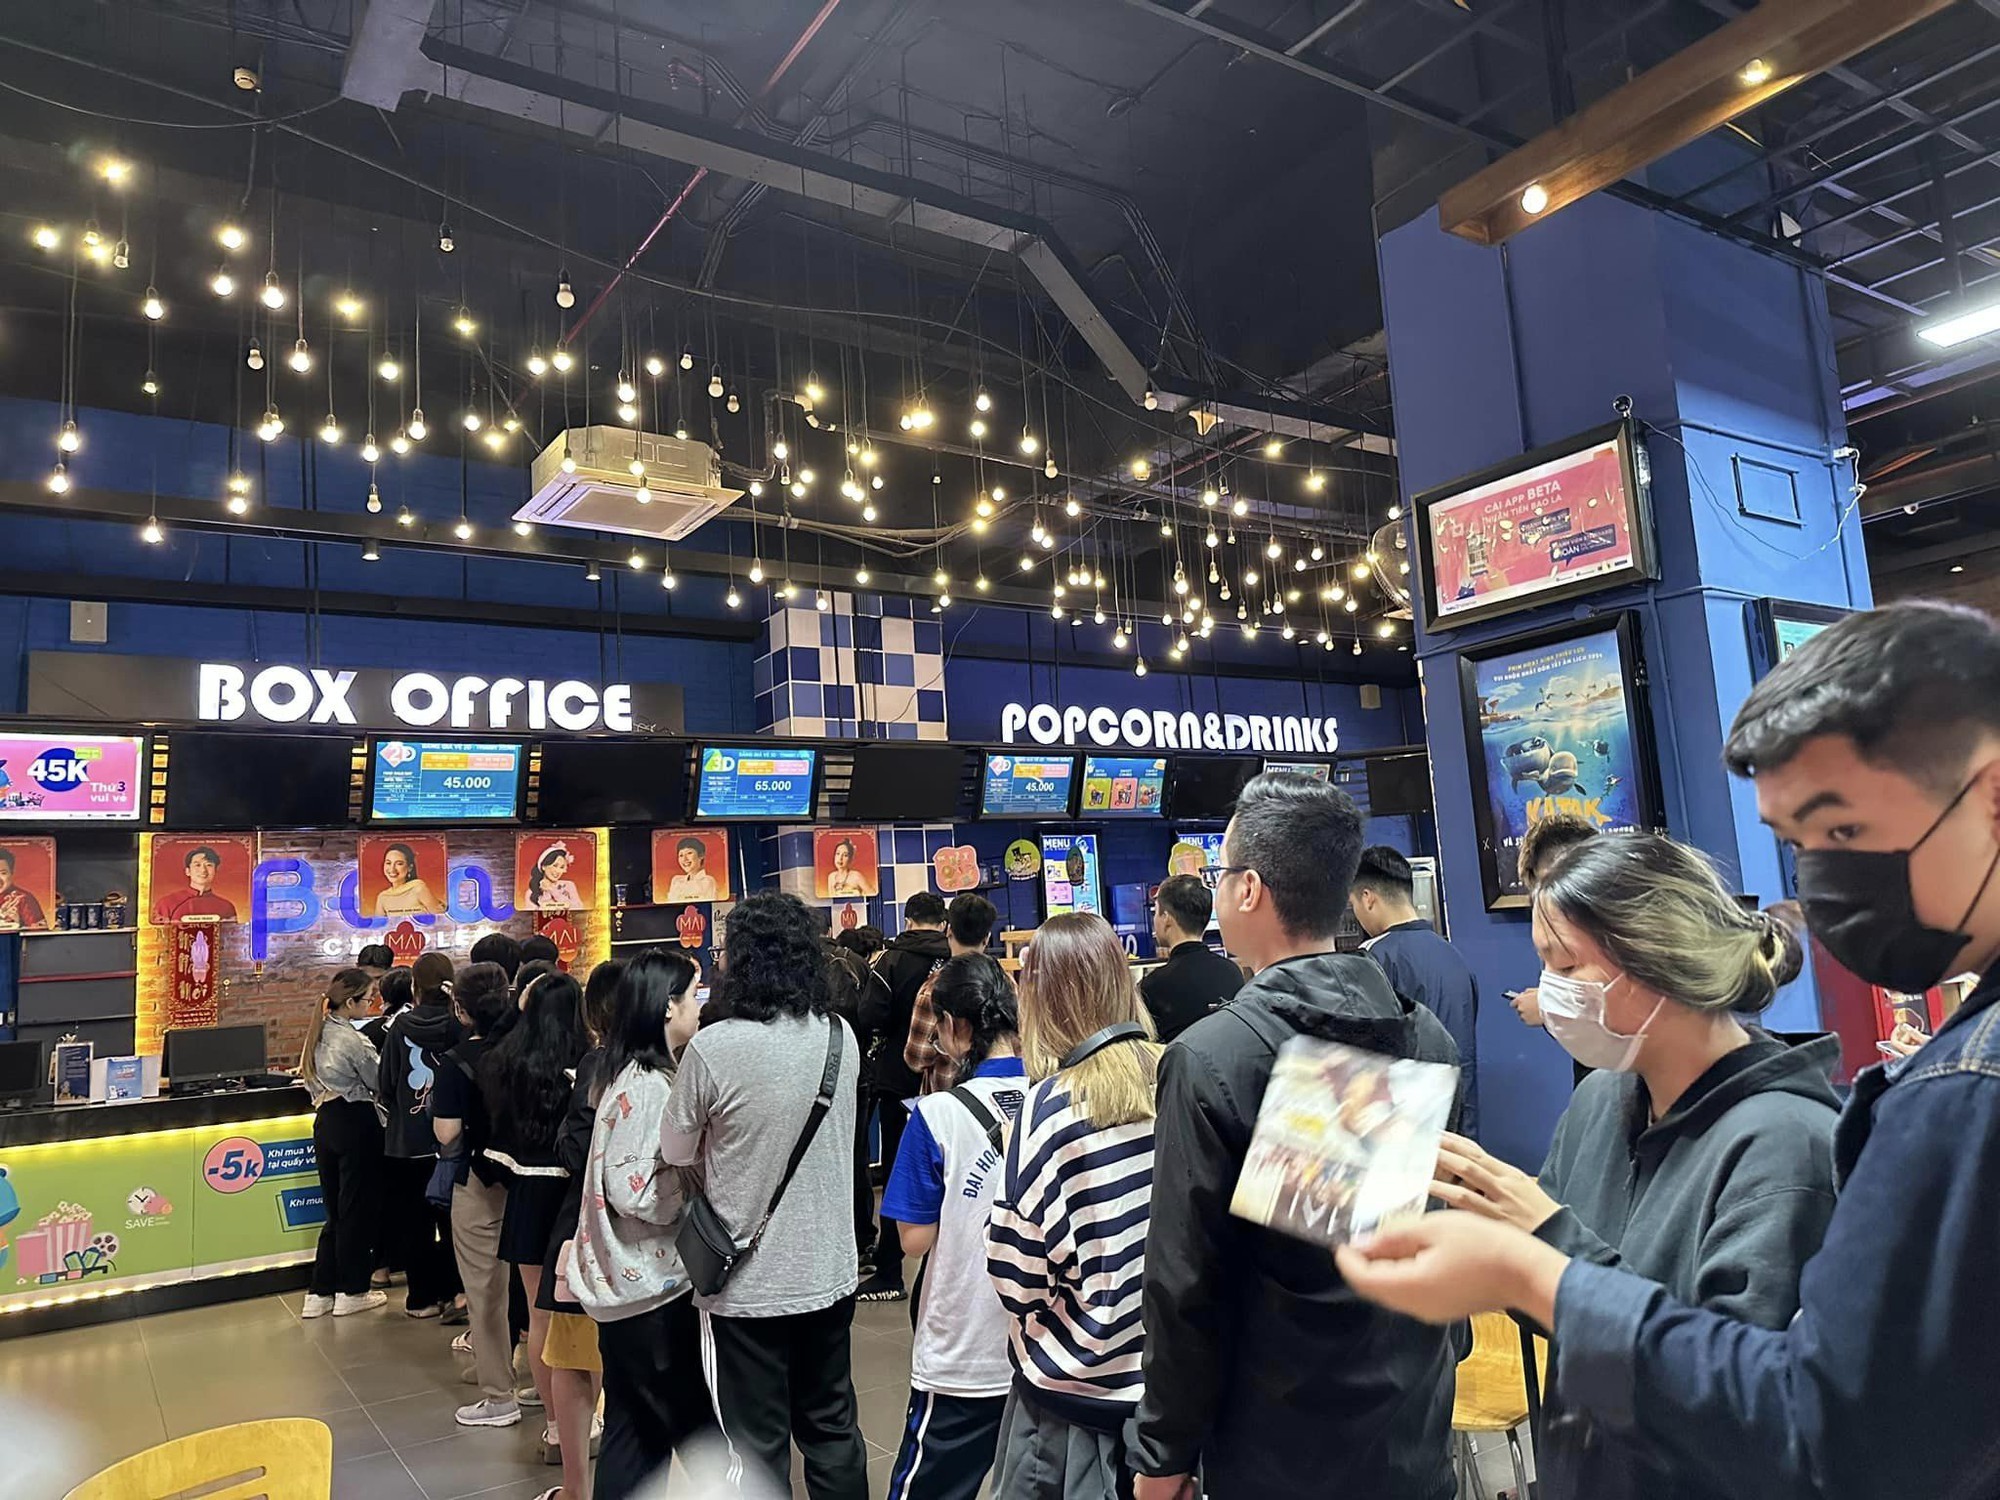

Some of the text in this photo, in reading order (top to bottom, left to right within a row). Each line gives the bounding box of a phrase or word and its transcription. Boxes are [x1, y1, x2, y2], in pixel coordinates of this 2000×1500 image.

[1505, 494, 1525, 507] APP
[1527, 480, 1561, 500] BETA
[199, 663, 632, 732] BOX OFFICE
[1001, 702, 1338, 753] POPCORN&DRINKS
[27, 759, 90, 782] 45K
[443, 776, 491, 789] 45.000
[754, 780, 792, 791] 65.000
[1025, 782, 1054, 792] 45.000
[90, 793, 109, 802] vui
[1043, 838, 1071, 848] MENU
[1179, 837, 1204, 847] MENU
[681, 916, 703, 931] MAI
[388, 934, 422, 950] MAI
[268, 1148, 284, 1158] Khi
[284, 1148, 304, 1157] mua
[208, 1149, 260, 1181] -5k
[963, 1172, 984, 1199] ĐẠI
[290, 1198, 305, 1208] Khi
[125, 1217, 155, 1229] SAVE
